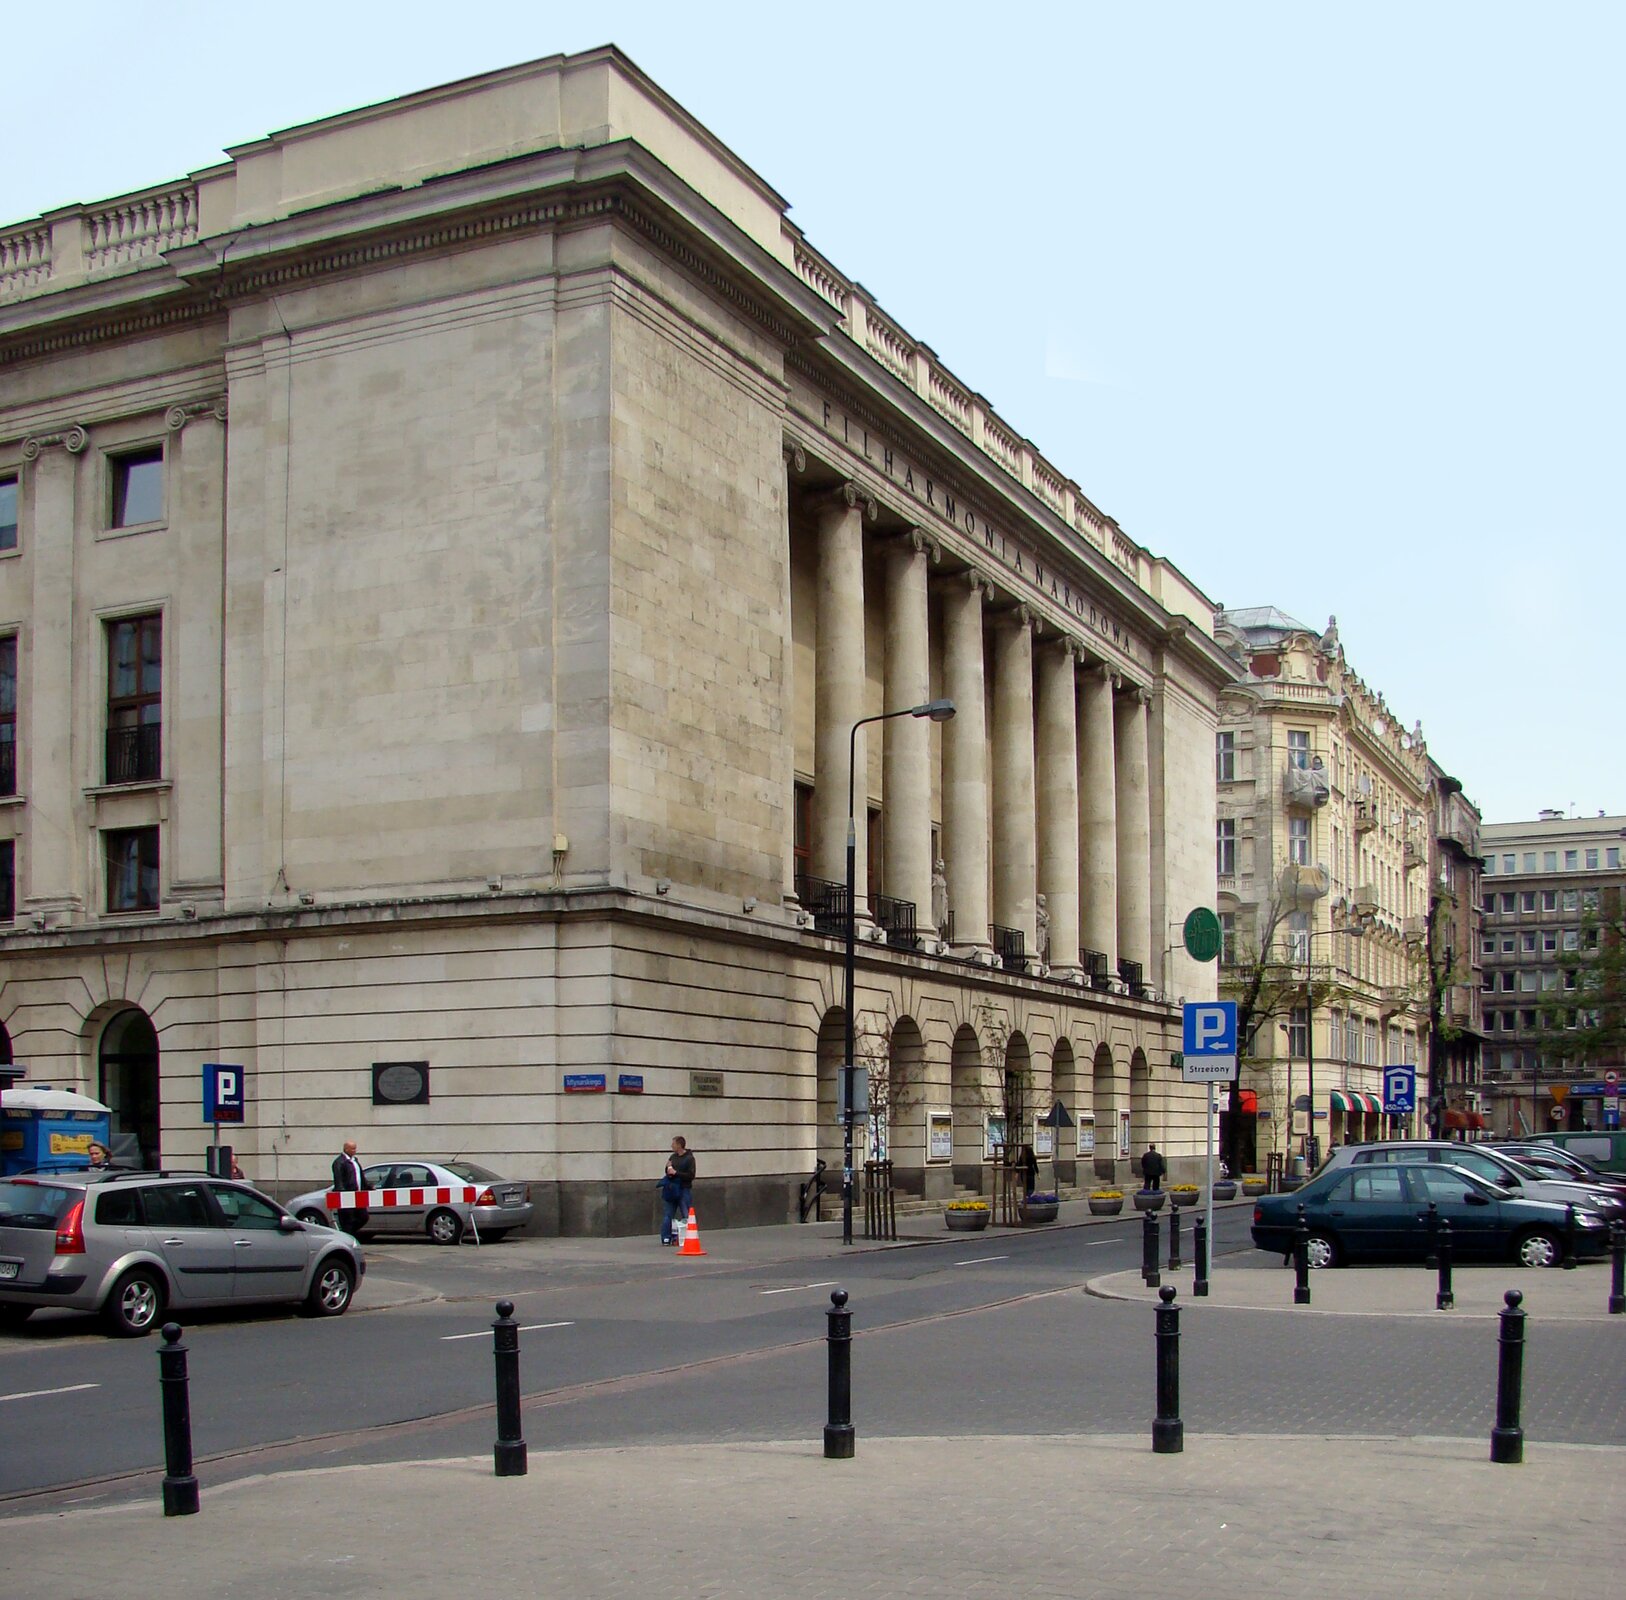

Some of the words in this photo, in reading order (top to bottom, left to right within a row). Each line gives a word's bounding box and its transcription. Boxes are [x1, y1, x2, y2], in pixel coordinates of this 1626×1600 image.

[823, 400, 1023, 573] FILHARMONIA
[1034, 563, 1130, 654] NARODOWA
[1195, 1008, 1226, 1049] P
[1188, 1065, 1230, 1075] Strzeżony
[217, 1071, 236, 1105] P
[1389, 1076, 1408, 1101] P
